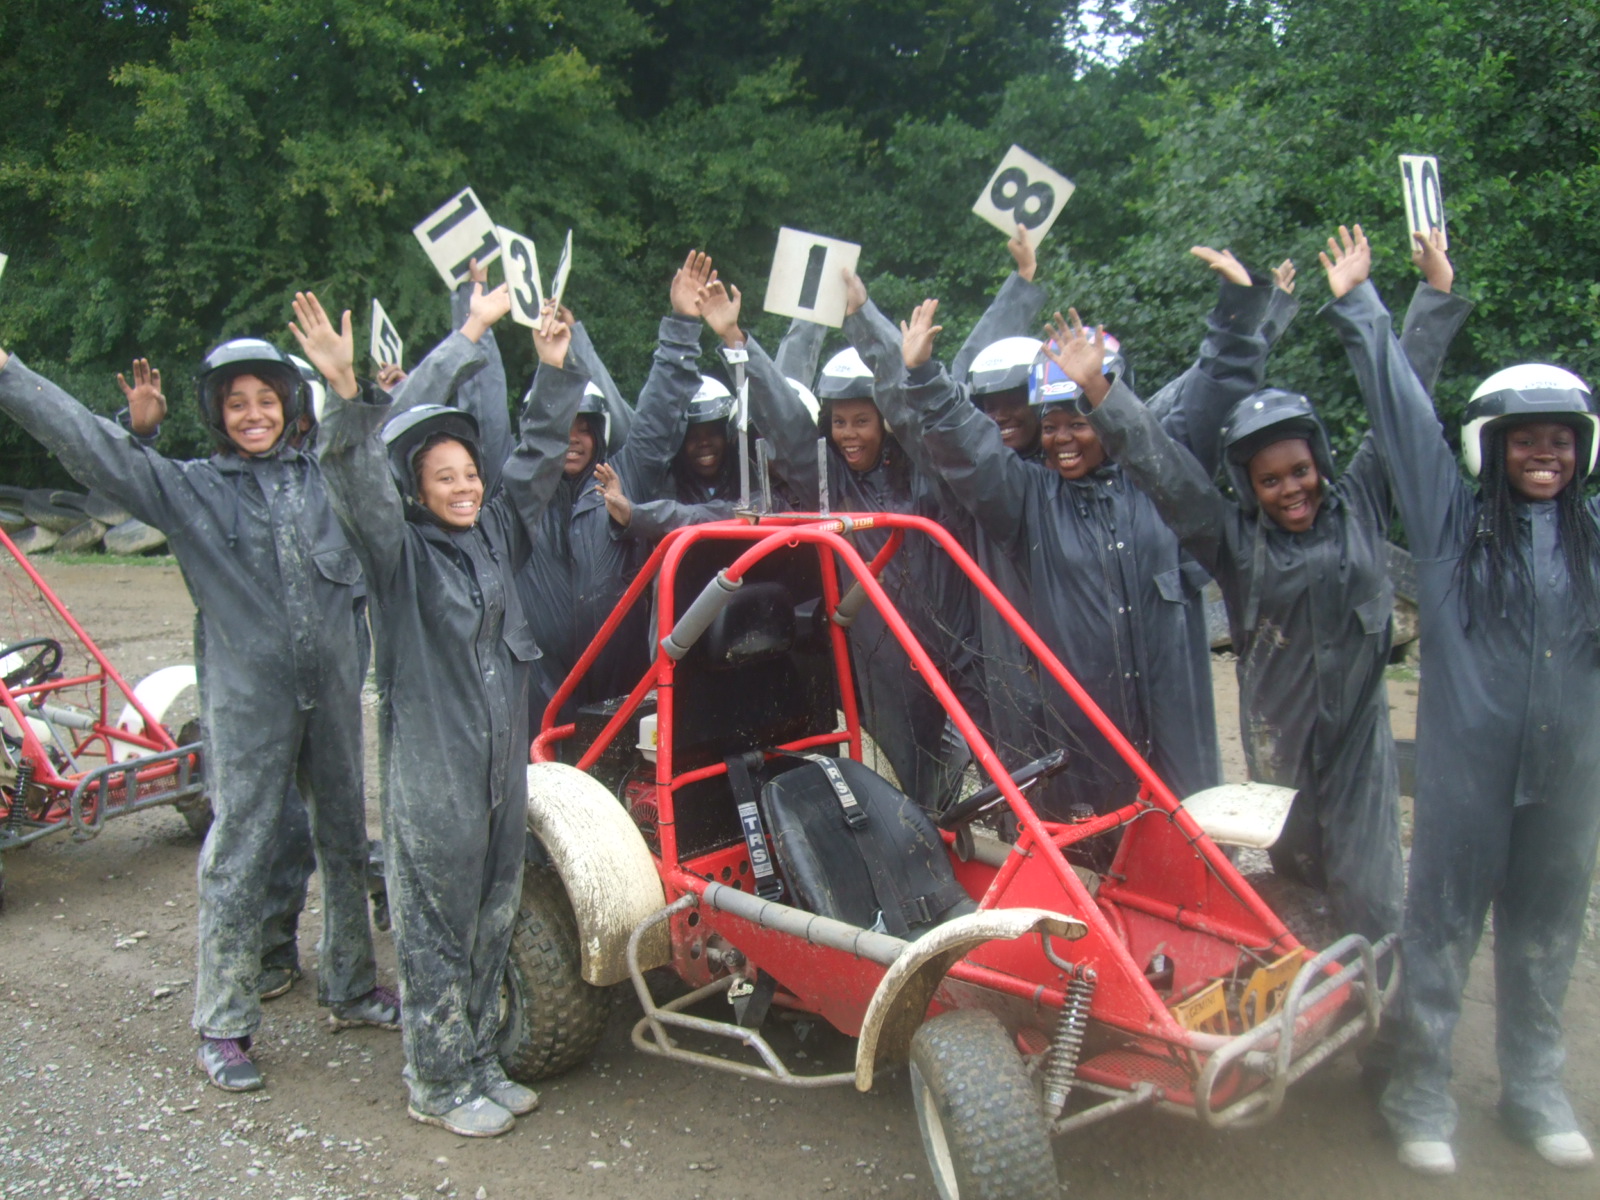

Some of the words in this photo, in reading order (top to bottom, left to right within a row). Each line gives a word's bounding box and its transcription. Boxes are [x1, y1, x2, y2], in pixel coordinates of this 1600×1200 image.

[990, 166, 1055, 230] 8
[1402, 160, 1443, 233] 10
[426, 192, 500, 281] 11
[510, 238, 541, 321] 3
[797, 243, 828, 310] 1
[378, 317, 399, 365] 5
[819, 757, 848, 794] TRS
[744, 816, 767, 863] TRS
